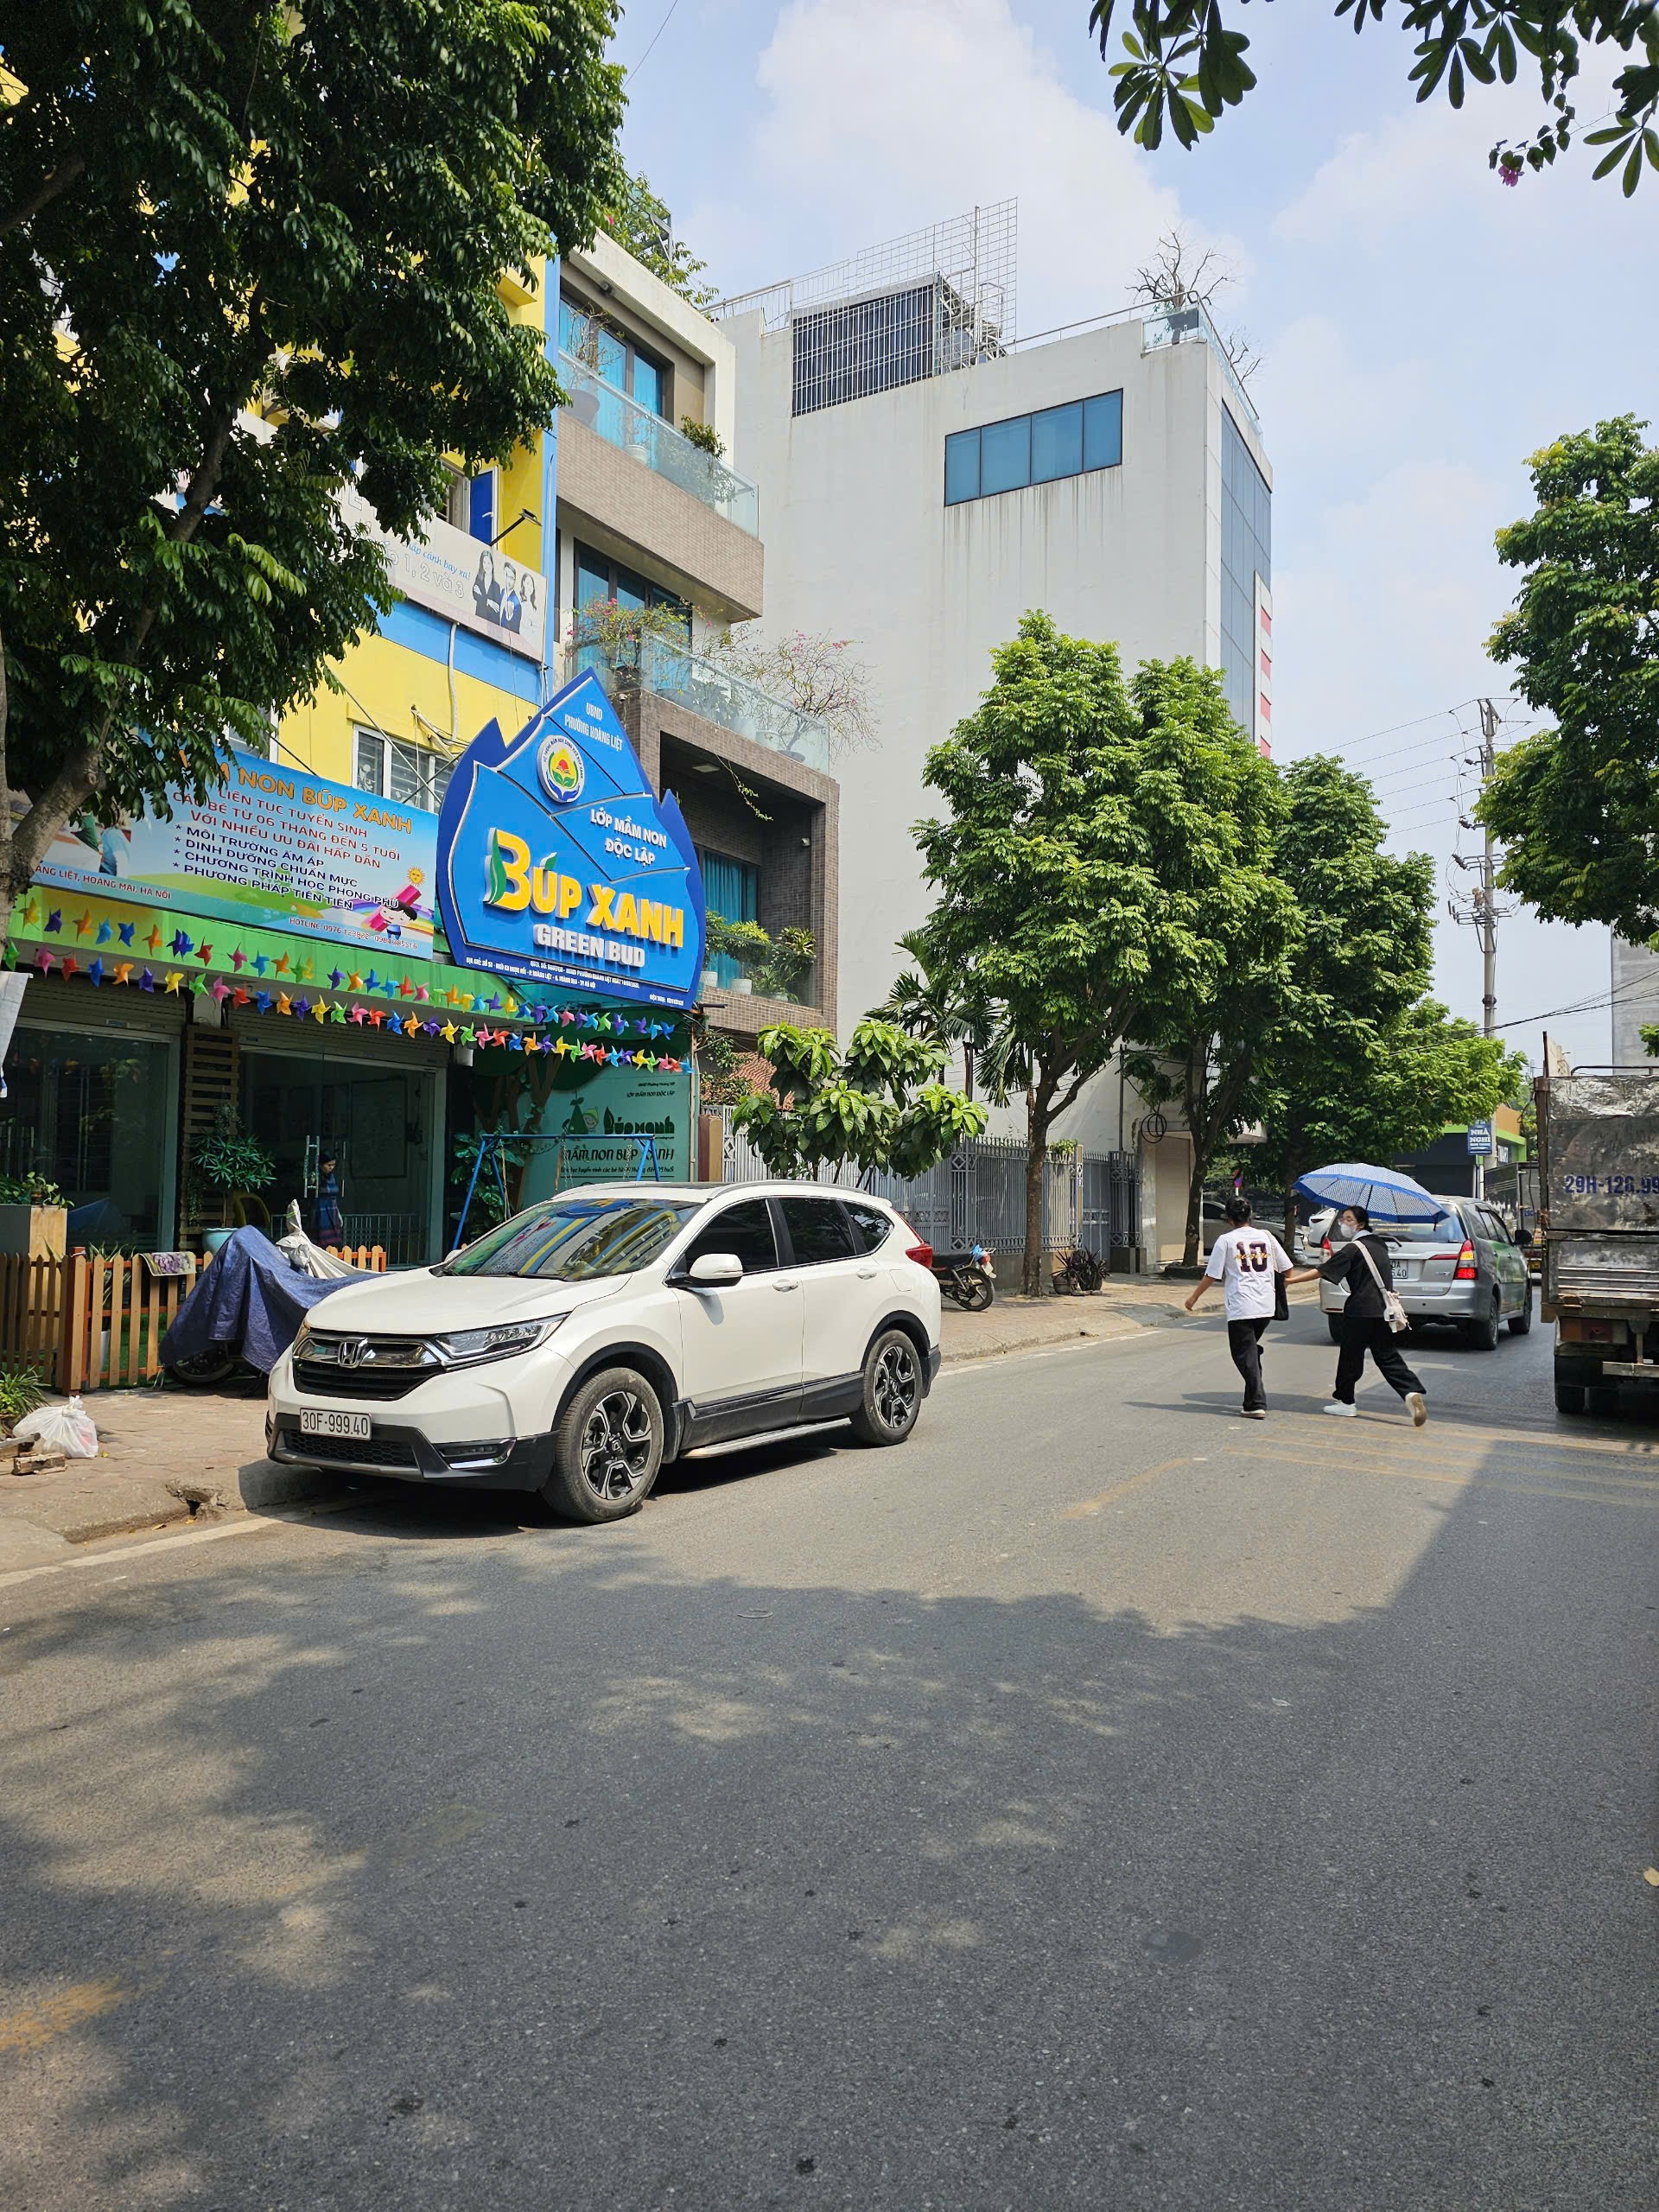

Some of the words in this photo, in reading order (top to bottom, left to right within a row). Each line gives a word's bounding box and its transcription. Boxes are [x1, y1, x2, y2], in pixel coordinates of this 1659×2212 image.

[421, 563, 429, 582] 2
[432, 572, 452, 593] và
[455, 581, 464, 598] 3
[423, 551, 442, 565] cánh
[443, 560, 457, 574] bay
[586, 702, 603, 721] UBND
[564, 714, 589, 736] PHƯỜNG
[590, 725, 610, 746] HOÀNG
[611, 734, 623, 752] LIỆT
[219, 790, 251, 805] LIÊN
[257, 799, 283, 815] TỤC
[289, 808, 333, 828] TUYỂN
[338, 822, 367, 838] SINH
[238, 767, 295, 799] NON
[302, 787, 346, 812] BÚP
[353, 802, 412, 834] XANH
[187, 827, 215, 841] MÔI
[219, 835, 278, 856] TRƯỜNG
[282, 850, 303, 863] ẤM
[307, 855, 324, 867] ÁP
[191, 810, 217, 826] VỚI
[273, 832, 293, 846] ƯU
[297, 838, 320, 853] ĐÃI
[325, 846, 351, 860] HẤP
[354, 854, 380, 868] DẪN
[208, 801, 227, 814] BÉ
[232, 806, 252, 820] TỪ
[257, 815, 275, 827] 06
[279, 820, 326, 841] THÁNG
[331, 835, 357, 849] ĐẾN
[361, 843, 368, 852] 5
[372, 845, 400, 861] TUỔI
[590, 807, 612, 827] LỚP
[613, 816, 642, 838] MẦM
[643, 830, 666, 849] NON
[186, 839, 222, 855] DINH
[226, 849, 276, 868] DƯỠNG
[281, 862, 326, 880] CHUẨN
[329, 874, 358, 887] MỰC
[605, 838, 632, 859] ĐỘC
[634, 847, 656, 867] LẬP
[35, 864, 56, 876] ÀNG
[59, 869, 80, 882] LIỆT,
[83, 874, 116, 888] HOÀNG
[119, 882, 137, 893] MAI,
[140, 886, 153, 896] HÀ
[184, 864, 247, 886] PHƯƠNG
[251, 880, 289, 894] PHÁP
[185, 851, 249, 873] CHƯƠNG
[252, 867, 294, 884] TRÌNH
[297, 878, 324, 891] HỌC
[328, 886, 371, 901] PHONG
[374, 896, 399, 908] PHÚ
[483, 827, 582, 918] BÚP
[586, 884, 683, 948] XANH
[324, 925, 341, 934] 0976
[533, 924, 605, 958] GREEN
[606, 940, 645, 968] BUD
[1471, 1128, 1490, 1136] NHÀ
[1236, 1241, 1268, 1272] 10
[302, 1410, 369, 1437] 30F-999.40
